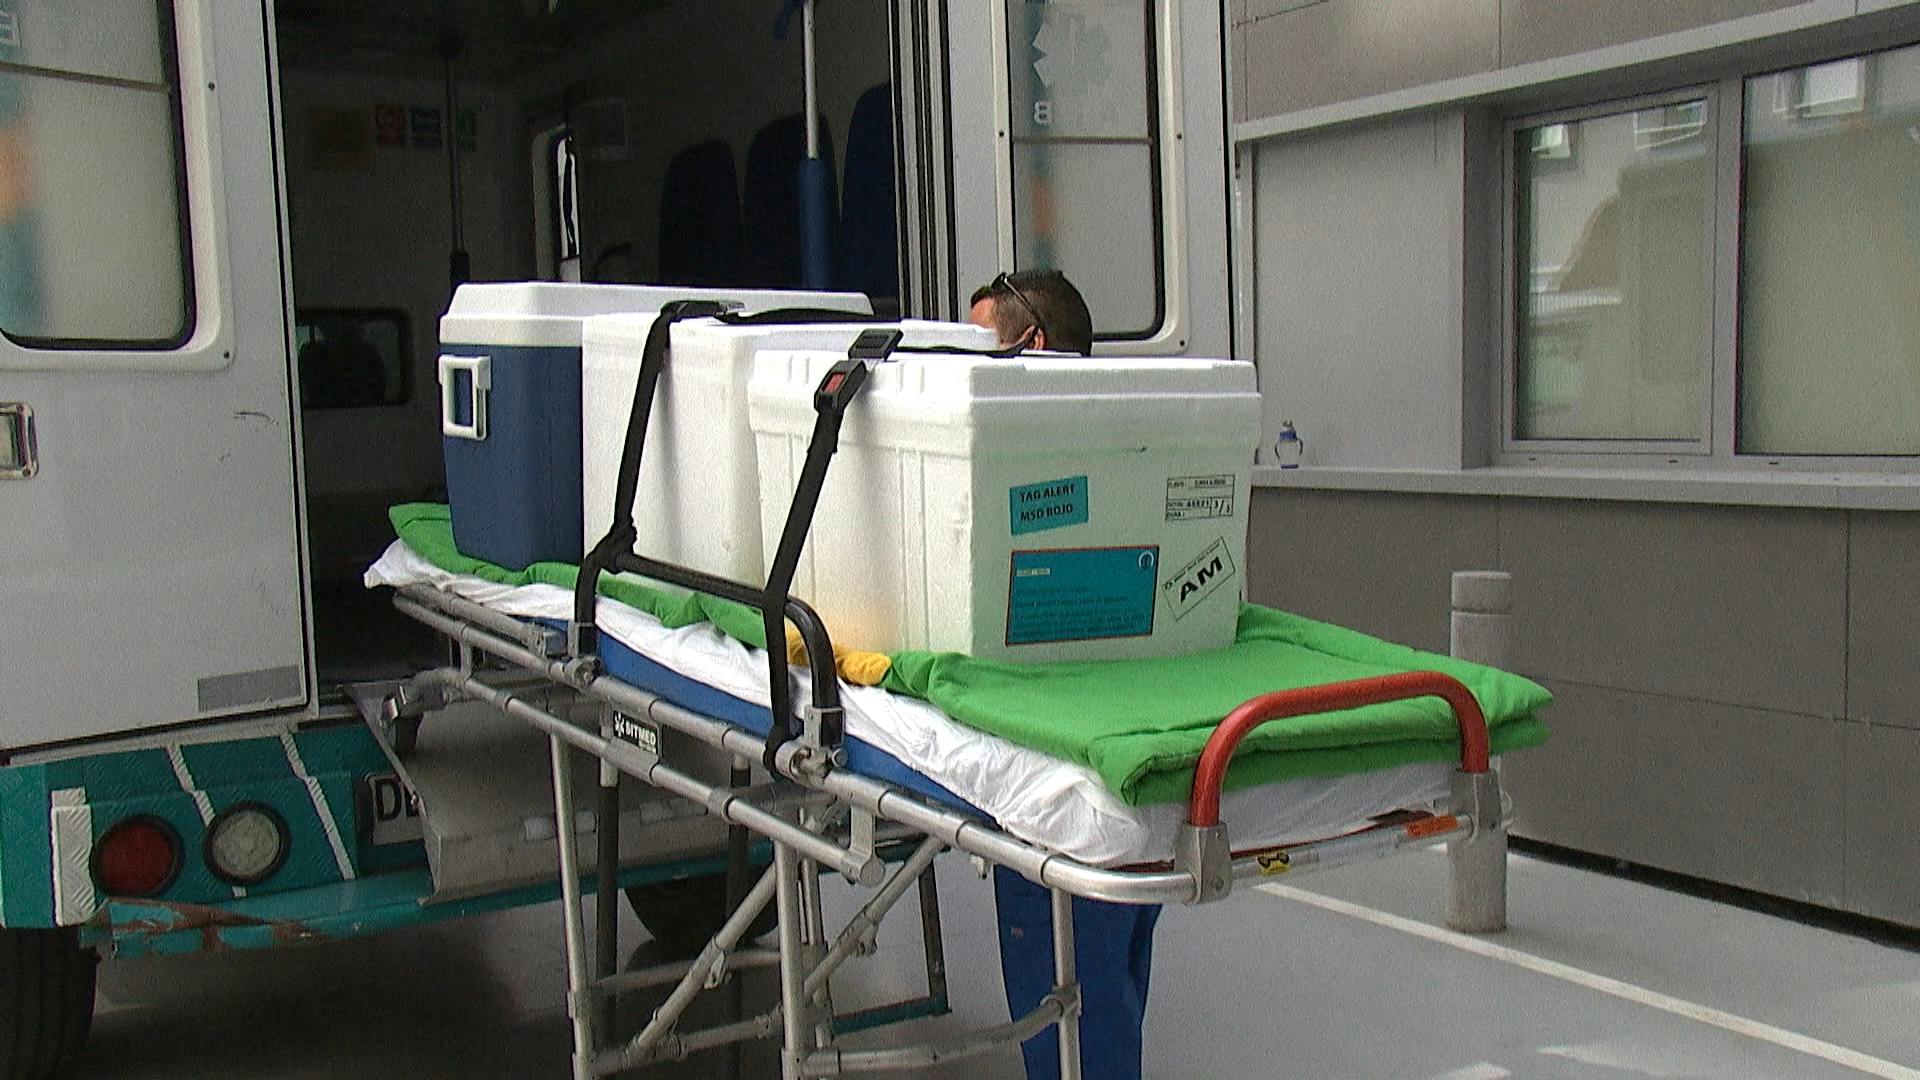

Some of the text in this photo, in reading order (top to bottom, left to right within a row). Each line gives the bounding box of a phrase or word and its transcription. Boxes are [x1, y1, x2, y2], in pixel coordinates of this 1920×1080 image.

[1021, 484, 1074, 503] TAG ALERT
[1021, 508, 1044, 522] MSD
[1180, 556, 1223, 603] AM
